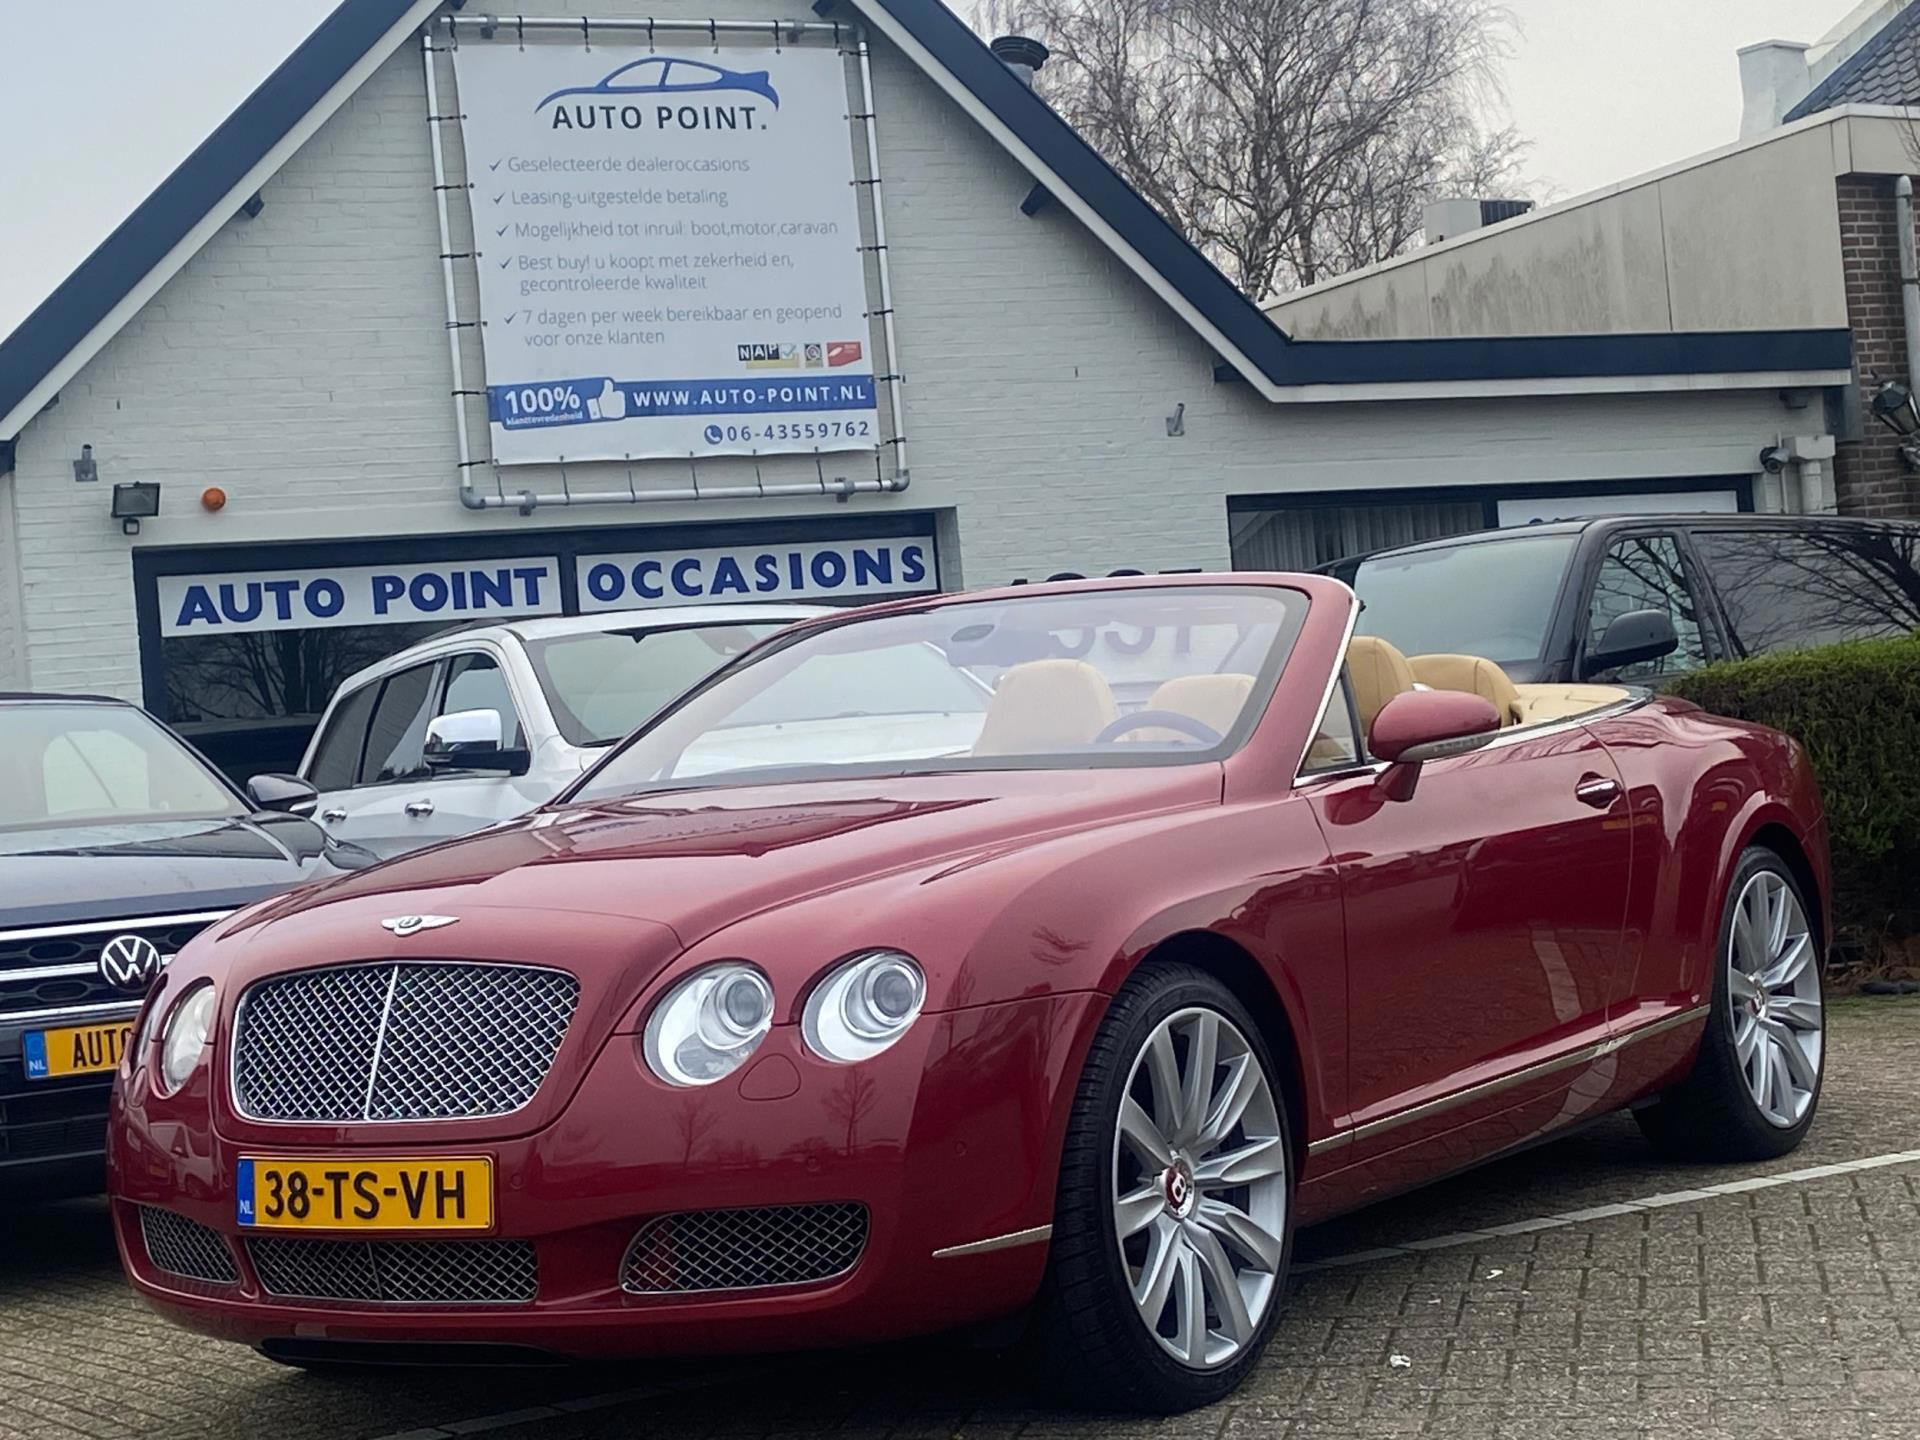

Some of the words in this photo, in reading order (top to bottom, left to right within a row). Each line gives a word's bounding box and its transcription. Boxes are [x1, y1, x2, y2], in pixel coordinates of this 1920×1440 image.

[552, 105, 642, 130] AUTO
[508, 156, 622, 172] Geselecteerde
[626, 155, 750, 172] dealeroccasions
[511, 188, 663, 208] Leasing-uitgestelde
[666, 188, 728, 206] betaling
[514, 222, 614, 241] Mogelijkheid
[618, 222, 639, 236] tot
[518, 255, 552, 270] Best
[557, 254, 589, 273] buy!
[595, 258, 605, 269] u
[609, 253, 655, 273] koopt
[659, 254, 688, 269] met
[693, 250, 767, 268] zekerheid
[771, 254, 794, 269] en,
[520, 275, 640, 296] gecontroleerde
[645, 274, 707, 291] kwaliteit
[524, 310, 533, 325] 7
[538, 308, 586, 328] dagen
[592, 309, 617, 327] per
[622, 307, 663, 323] week
[667, 305, 749, 322] bereikbaar
[753, 307, 772, 320] en
[776, 304, 842, 324] geopend
[525, 332, 559, 347] voor
[565, 331, 603, 346] onze
[608, 328, 665, 345] klanten
[738, 344, 779, 361] NAP
[504, 386, 581, 415] 100%
[633, 385, 867, 408] WWW.AUTO-POINT.NL
[727, 421, 870, 442] 06-43559762
[587, 545, 926, 602] OCCASIONS
[176, 578, 345, 627] AUTO
[371, 566, 548, 615] POINT
[28, 1060, 46, 1071] NL
[264, 1170, 466, 1220] 38-TS-VH
[239, 1200, 253, 1215] NL
